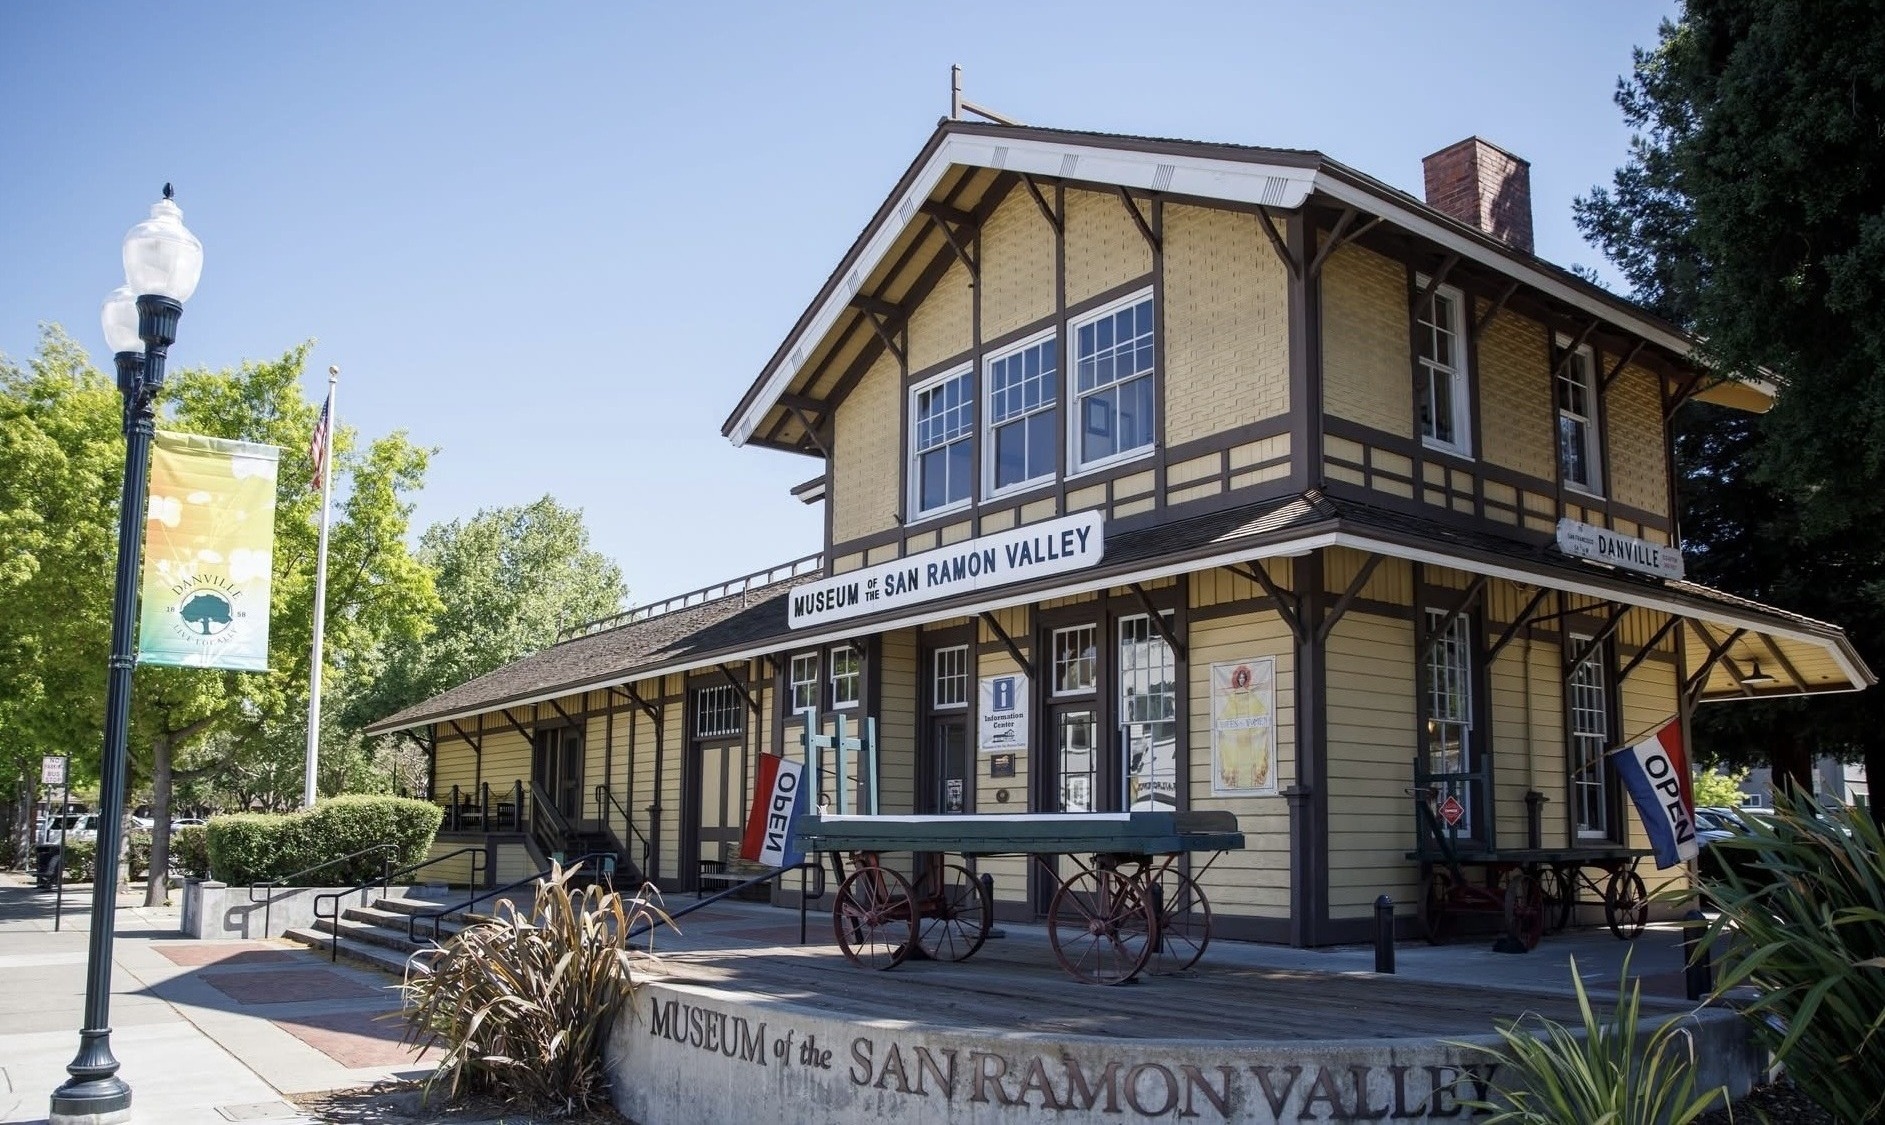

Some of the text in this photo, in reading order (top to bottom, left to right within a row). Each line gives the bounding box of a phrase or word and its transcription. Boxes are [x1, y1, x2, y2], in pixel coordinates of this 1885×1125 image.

[1598, 534, 1659, 568] DANVILLE
[794, 525, 1092, 618] MUSEUM OF SAN RAMON VALLEY
[171, 574, 243, 600] DANVILLE
[865, 589, 880, 602] THE
[984, 712, 1024, 722] Information
[993, 721, 1015, 729] Center
[1645, 755, 1695, 845] OPEN
[650, 997, 1501, 1121] MUSEUM of the SAN RAMON VALLEY
